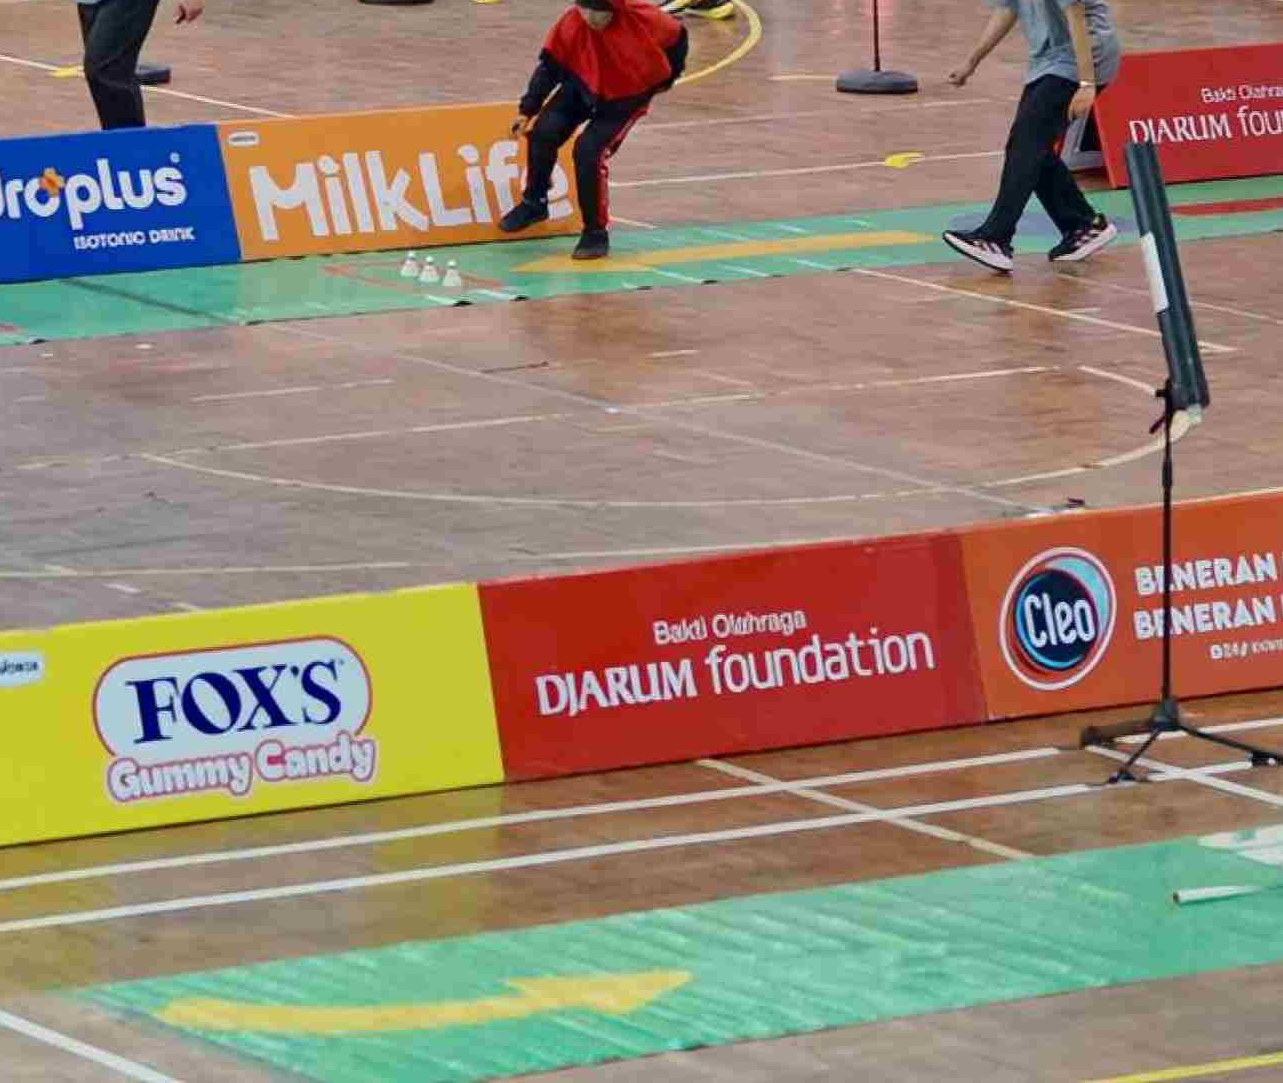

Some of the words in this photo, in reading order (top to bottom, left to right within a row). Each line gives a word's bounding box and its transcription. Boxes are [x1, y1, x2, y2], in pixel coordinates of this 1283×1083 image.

[1023, 593, 1096, 650] Cleo
[125, 657, 342, 745] FOX'S
[535, 660, 698, 717] DJARUM
[704, 627, 935, 695] foundation
[109, 755, 252, 801] Gummy
[255, 734, 376, 782] Candy
